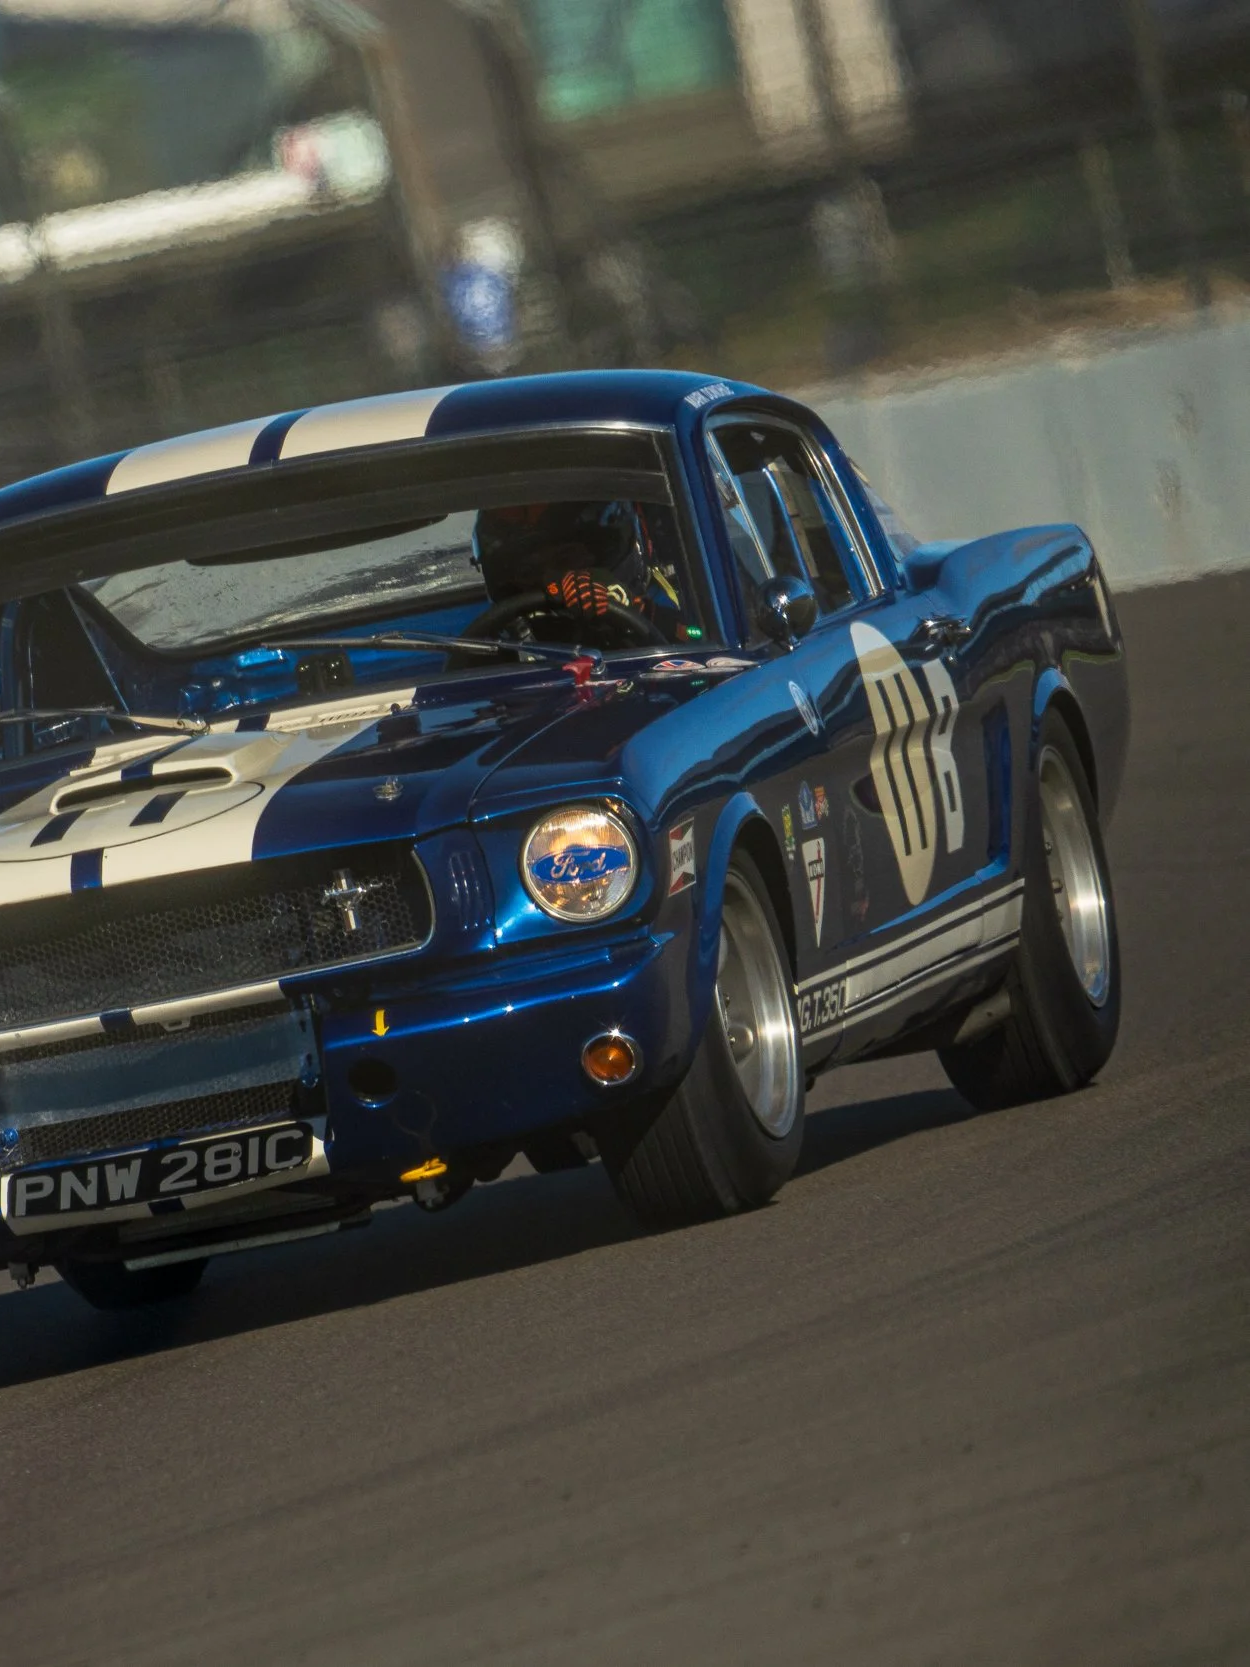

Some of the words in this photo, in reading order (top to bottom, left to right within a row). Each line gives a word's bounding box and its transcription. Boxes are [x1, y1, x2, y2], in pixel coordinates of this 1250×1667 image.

[550, 850, 607, 879] Ford
[14, 1158, 142, 1217] PNW
[159, 1129, 304, 1193] 281C
